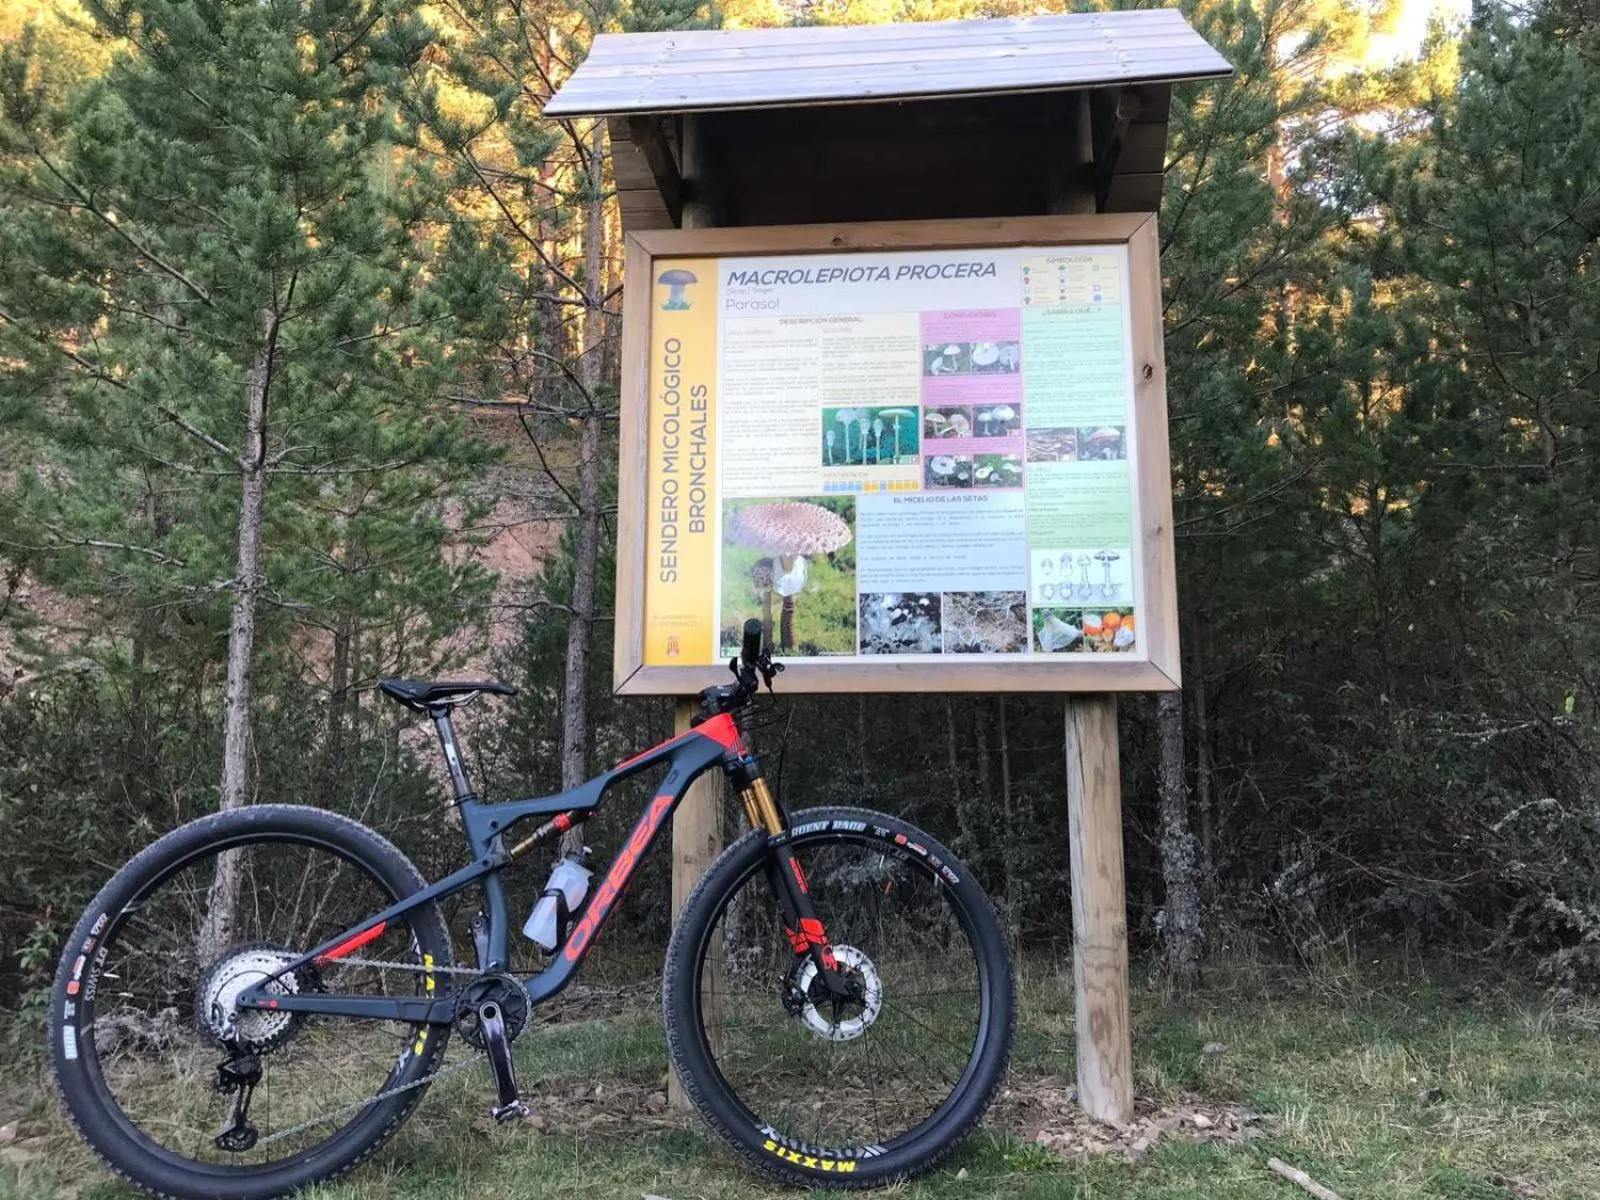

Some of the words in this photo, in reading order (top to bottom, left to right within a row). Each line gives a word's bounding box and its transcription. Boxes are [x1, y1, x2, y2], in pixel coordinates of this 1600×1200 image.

[727, 266, 891, 287] MACROLEPIOTA
[895, 261, 997, 281] PROCERA
[725, 297, 780, 311] Parasol
[780, 315, 829, 326] DESCRIPCIÓN
[829, 315, 863, 325] GENERAL
[659, 338, 682, 474] MICOLÓGICO
[688, 383, 707, 533] BRONCHALES
[893, 496, 901, 504] EL
[903, 495, 935, 504] MICELIO
[935, 495, 946, 504] DE
[946, 495, 962, 503] LAS
[962, 494, 989, 503] SETAS
[660, 478, 679, 583] SENDERO
[565, 795, 674, 961] ORBEA
[96, 946, 109, 967] DT
[84, 966, 101, 1002] SWISS
[763, 1139, 856, 1173] MAXXIS
